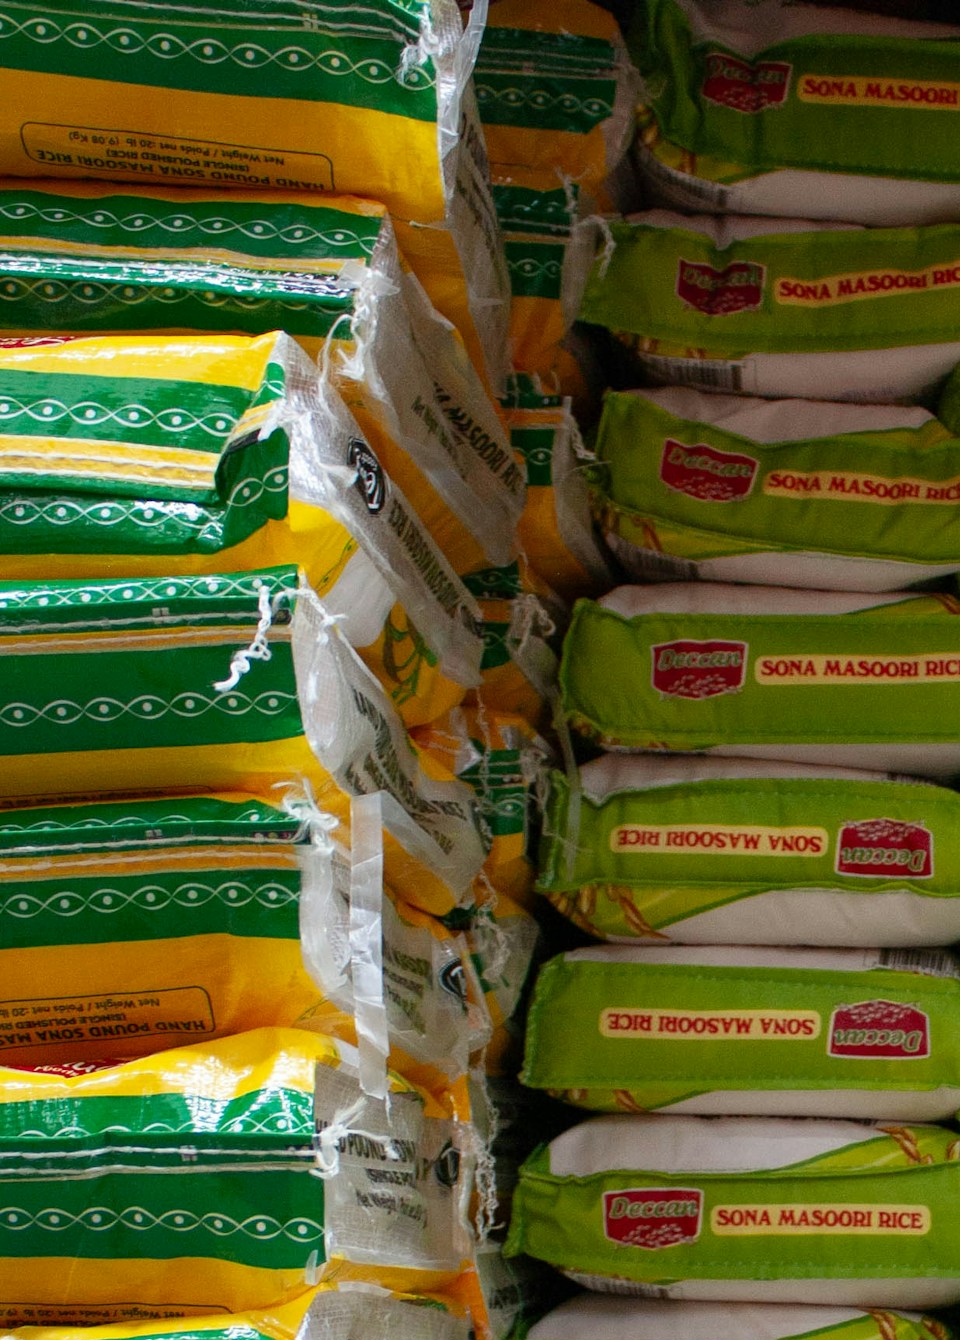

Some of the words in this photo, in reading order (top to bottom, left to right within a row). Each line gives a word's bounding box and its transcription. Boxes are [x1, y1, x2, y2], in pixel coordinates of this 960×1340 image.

[804, 78, 856, 98] SONA
[865, 81, 958, 106] MASOORI
[36, 150, 73, 164] RICE
[79, 155, 154, 175] MASOORI
[161, 164, 206, 179] SONA
[212, 170, 270, 186] POUND
[658, 649, 741, 671] Deccan
[761, 660, 817, 678] SONA
[823, 659, 919, 678] MASOORI
[616, 828, 659, 847] RICE
[665, 830, 763, 850] MASOORI
[768, 834, 822, 853] SONA
[842, 847, 926, 872] Deccan
[607, 1012, 653, 1032] RICE
[658, 1014, 754, 1034] MASOORI
[759, 1016, 815, 1036] SONA
[834, 1029, 922, 1053] Deccan
[609, 1197, 697, 1219] Deccan
[716, 1209, 771, 1228] SONA
[778, 1209, 872, 1230] MASOORI
[877, 1211, 924, 1230] RICE
